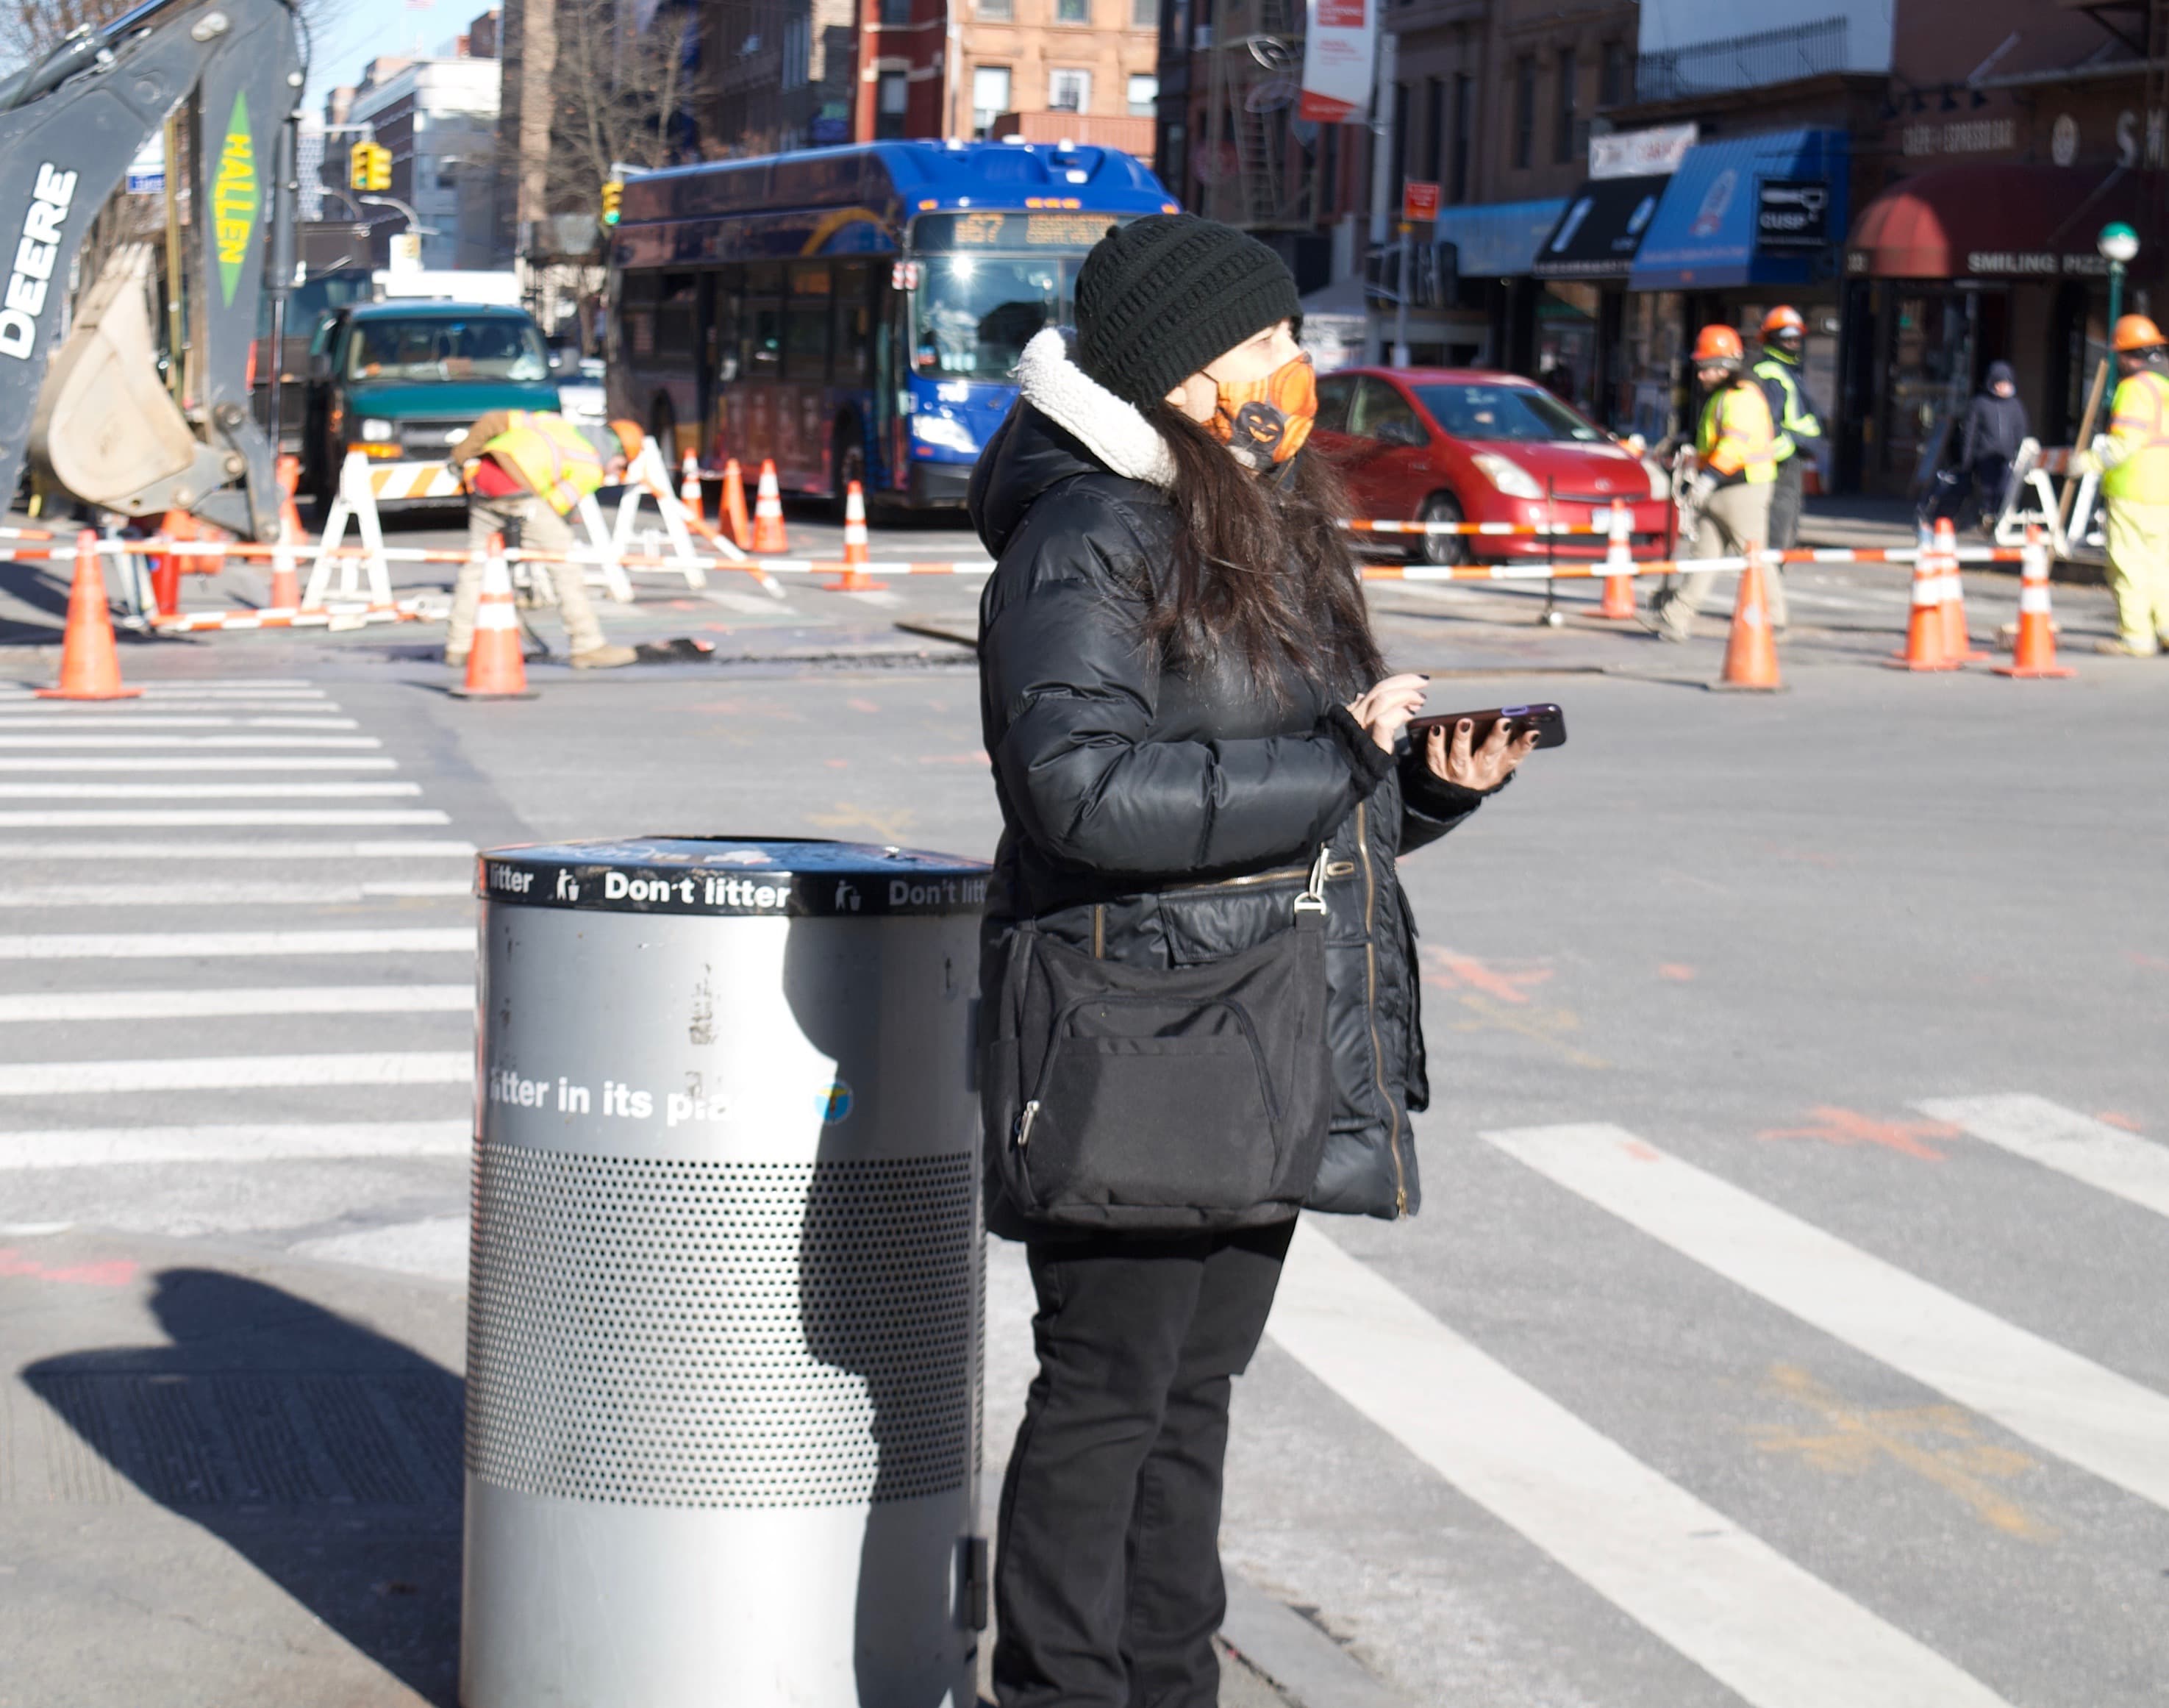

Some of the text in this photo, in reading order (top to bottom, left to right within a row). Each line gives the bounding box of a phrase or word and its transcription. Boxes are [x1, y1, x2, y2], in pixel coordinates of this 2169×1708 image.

[214, 133, 255, 264] HALLEN
[0, 162, 78, 359] DEERE
[1968, 253, 2109, 275] SMILING PIZZ
[490, 863, 534, 893] litter
[604, 871, 792, 908] Don't litter
[889, 878, 987, 906] Don't litt
[557, 1076, 590, 1114] in
[602, 1079, 654, 1119] its
